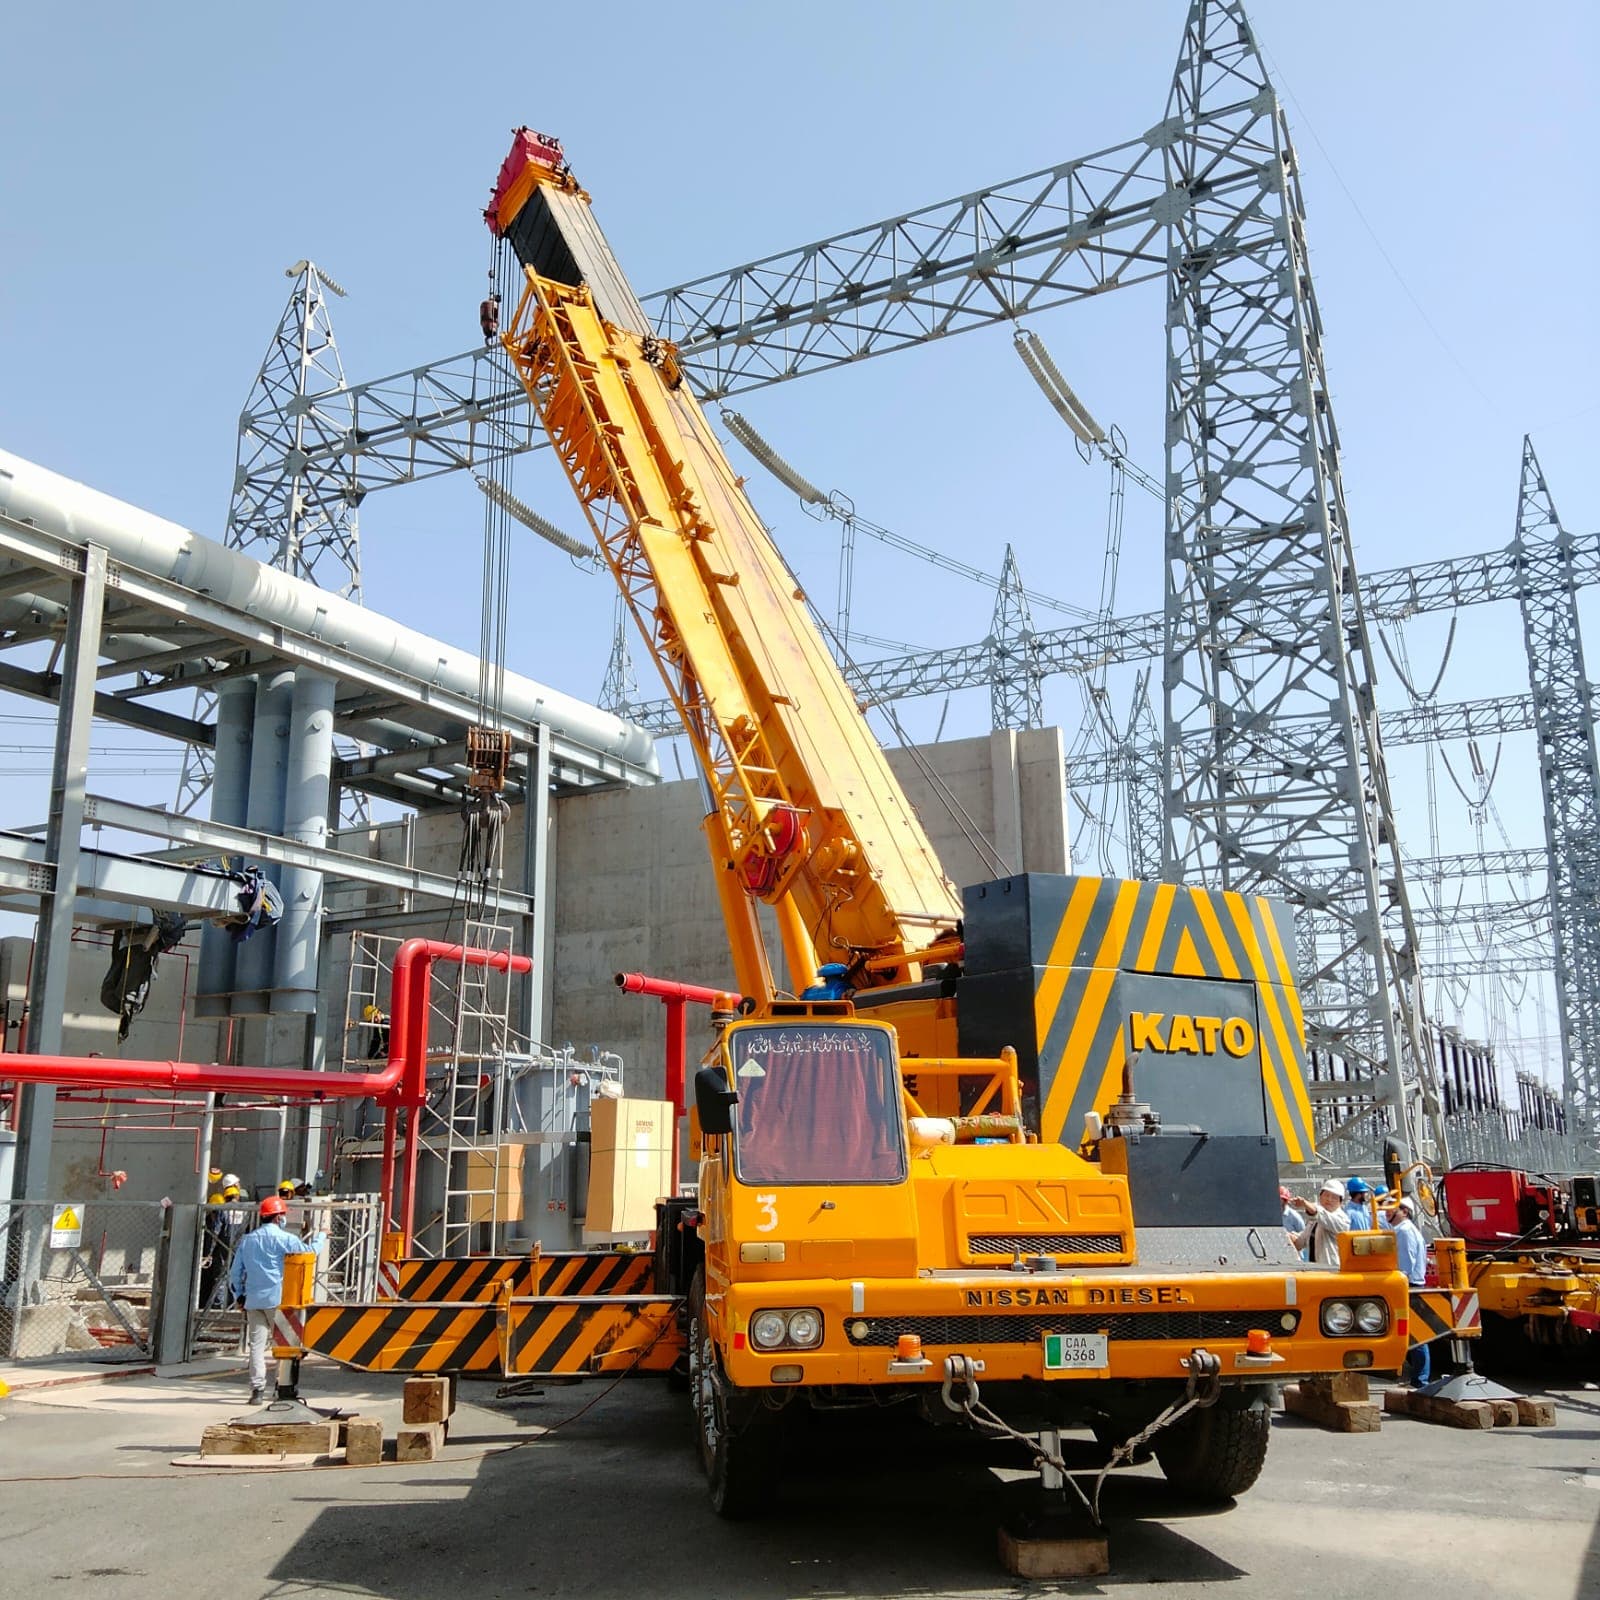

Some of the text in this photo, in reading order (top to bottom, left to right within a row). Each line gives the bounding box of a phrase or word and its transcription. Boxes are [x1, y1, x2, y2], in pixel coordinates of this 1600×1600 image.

[1130, 1011, 1255, 1058] KATO
[755, 1193, 778, 1232] 3
[967, 1287, 1188, 1307] NISSAN DIESEL
[1065, 1337, 1087, 1348] CAA
[1064, 1349, 1096, 1361] 6368
